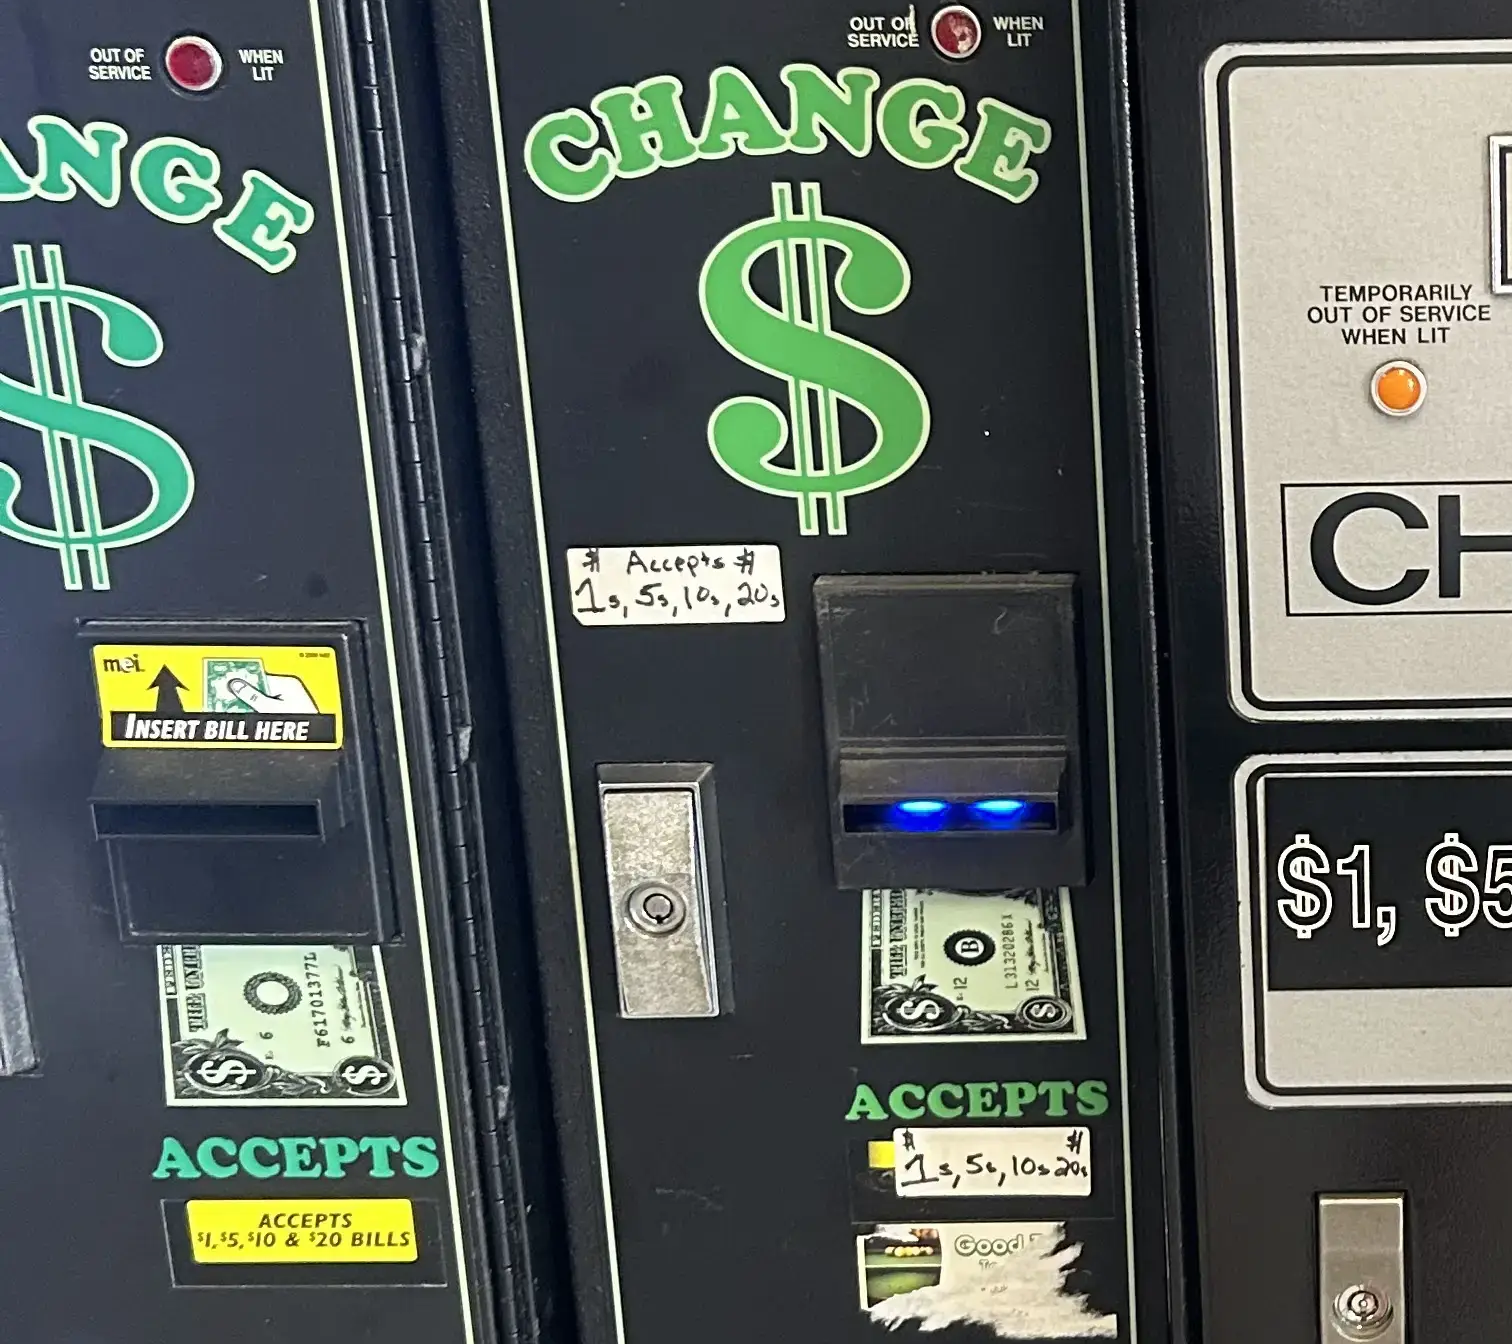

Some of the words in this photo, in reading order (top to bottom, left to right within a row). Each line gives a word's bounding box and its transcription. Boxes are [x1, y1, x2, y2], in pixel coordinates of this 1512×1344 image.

[848, 16, 885, 31] OUT
[993, 16, 1044, 31] WHEN
[847, 33, 919, 48] SERVICE
[1007, 33, 1032, 47] LIT
[90, 47, 121, 63] OUT
[124, 48, 145, 63] OF
[239, 49, 284, 64] WHEN
[88, 66, 152, 81] SERVICE
[252, 67, 275, 82] LIT
[524, 64, 1052, 203] CHANGE
[1320, 284, 1473, 303] TEMPORARILY
[1307, 306, 1353, 324] OUT
[1362, 306, 1392, 323] OF
[1399, 304, 1492, 323] SERVICE
[1341, 328, 1407, 345] WHEN
[1418, 327, 1451, 344] LIT
[699, 181, 931, 536] $
[627, 550, 726, 577] Accepts
[125, 712, 200, 740] INSERT
[204, 720, 250, 740] BILL
[254, 720, 310, 741] HERE
[1276, 833, 1397, 946] $1,
[960, 938, 980, 953] B
[844, 1080, 1109, 1120] ACCEPTS
[152, 1136, 440, 1178] ACCEPTS
[259, 1213, 353, 1229] ACCEPTS
[285, 1233, 299, 1247] &
[309, 1232, 342, 1248] $20
[351, 1232, 410, 1247] BILLS
[954, 1234, 1024, 1257] Good
